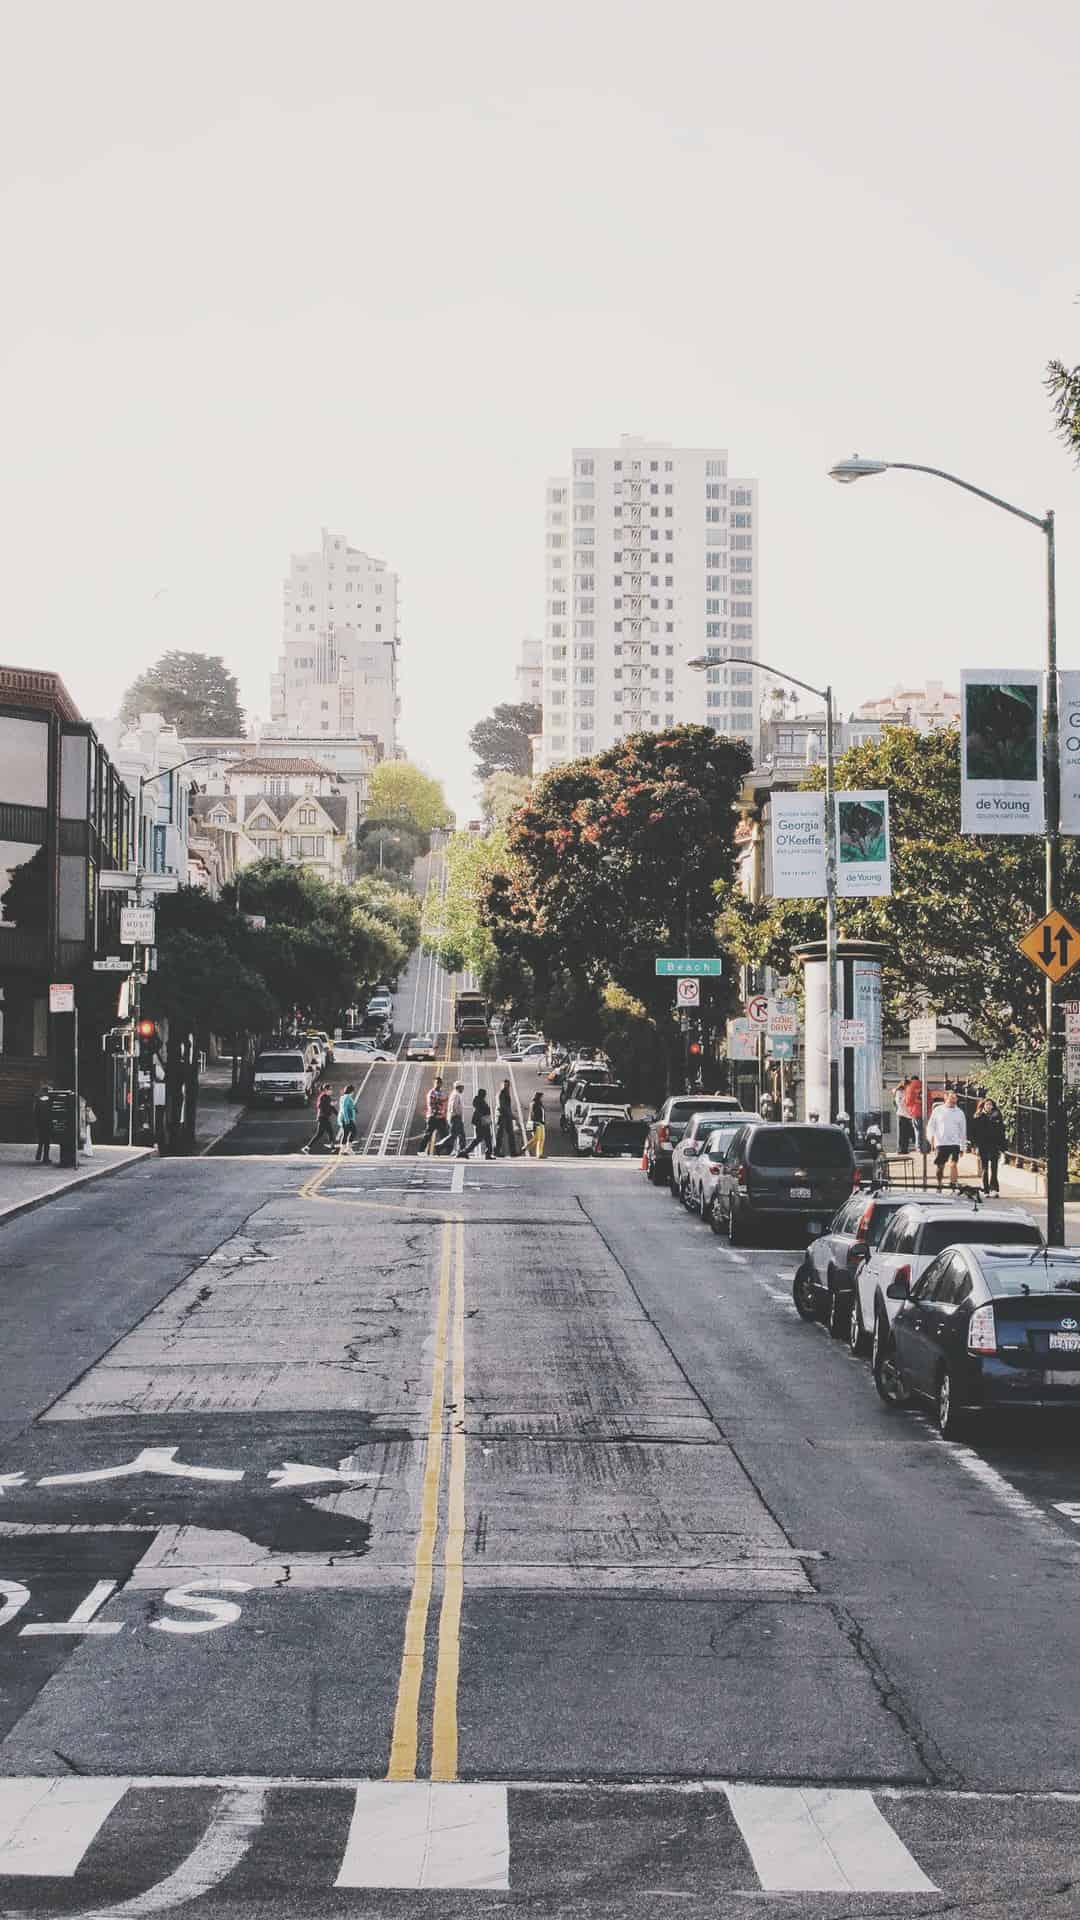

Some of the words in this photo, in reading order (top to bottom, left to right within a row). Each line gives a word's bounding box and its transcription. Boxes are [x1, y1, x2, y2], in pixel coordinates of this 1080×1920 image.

[975, 799, 991, 810] de
[993, 799, 1030, 813] Young
[778, 820, 819, 832] Georgia
[776, 834, 821, 846] O'Keeffe
[857, 872, 882, 883] Young
